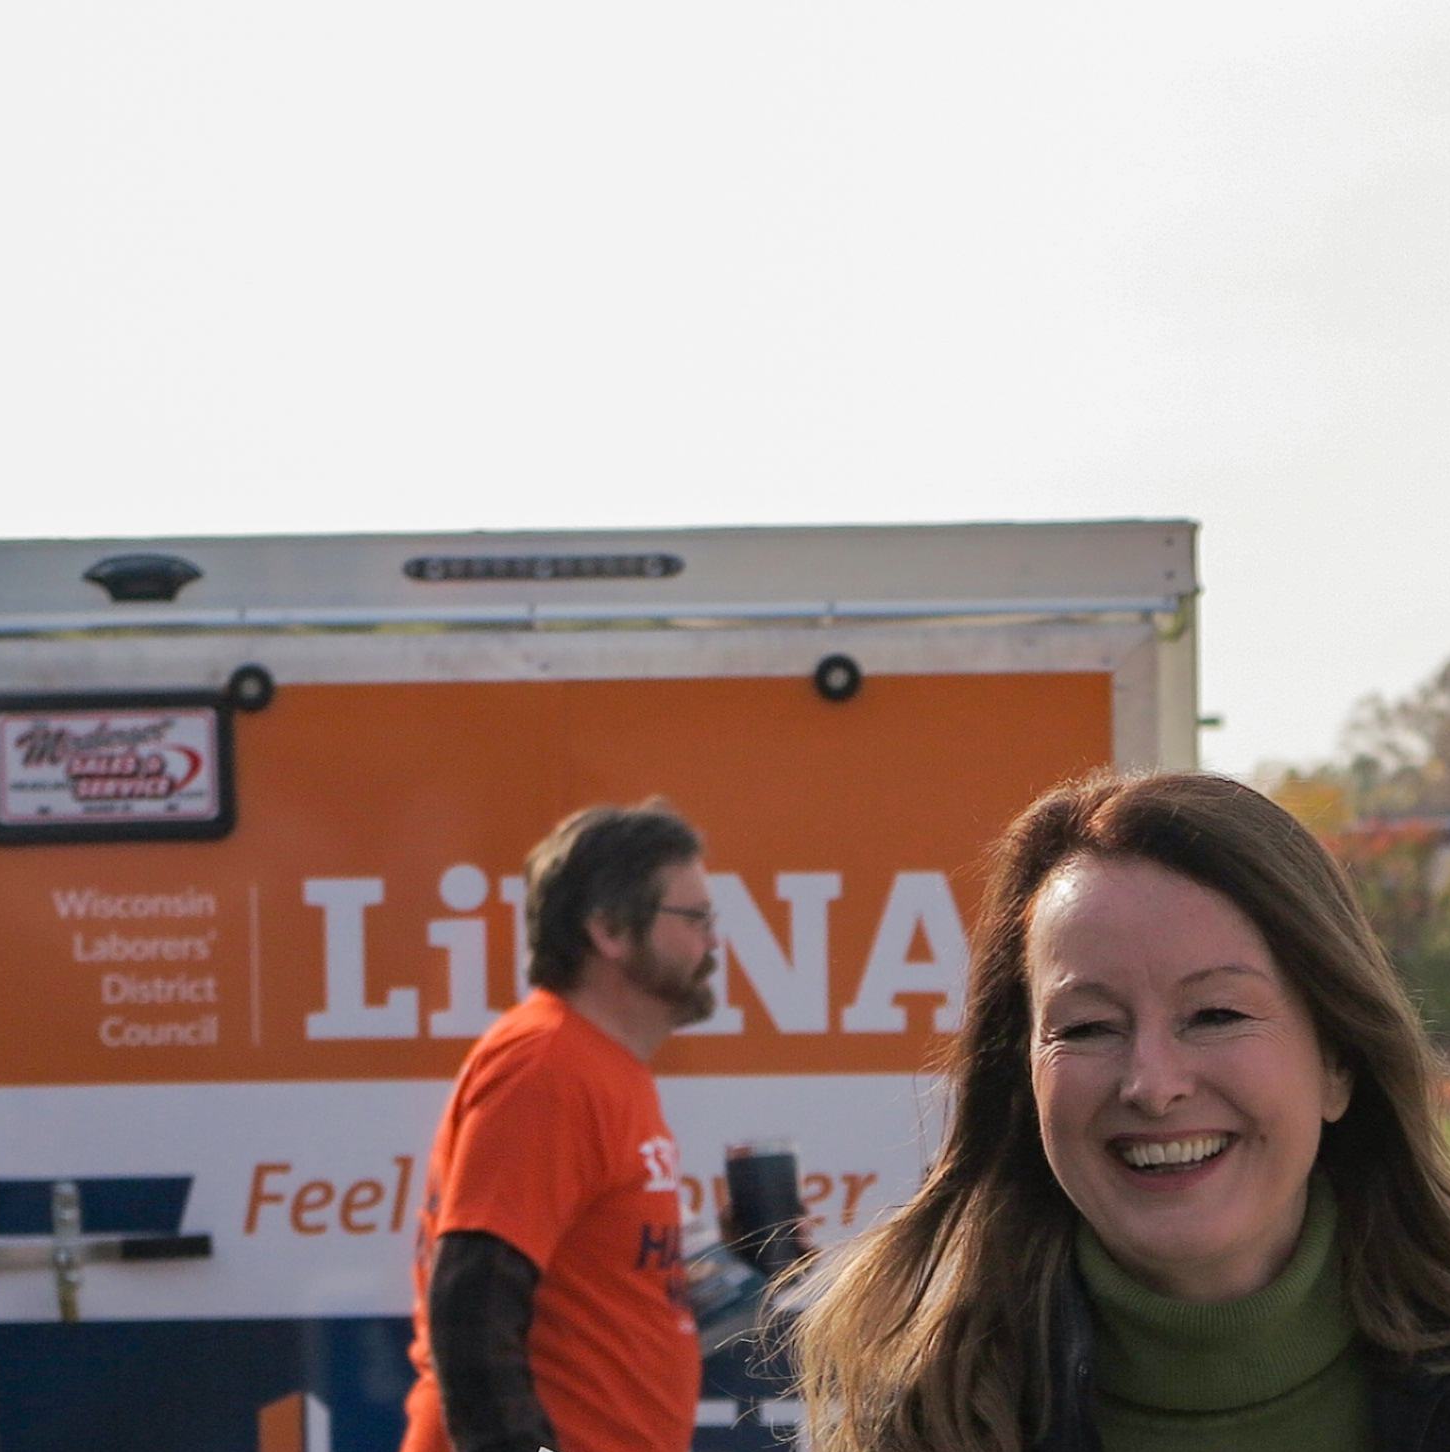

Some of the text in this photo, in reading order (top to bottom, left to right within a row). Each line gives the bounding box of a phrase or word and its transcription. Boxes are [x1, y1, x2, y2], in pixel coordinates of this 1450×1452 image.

[52, 886, 216, 919] Wisconsin
[303, 864, 977, 1041] LiNA
[101, 973, 218, 1004] District
[98, 1015, 218, 1046] Council
[243, 1154, 415, 1236] Feel
